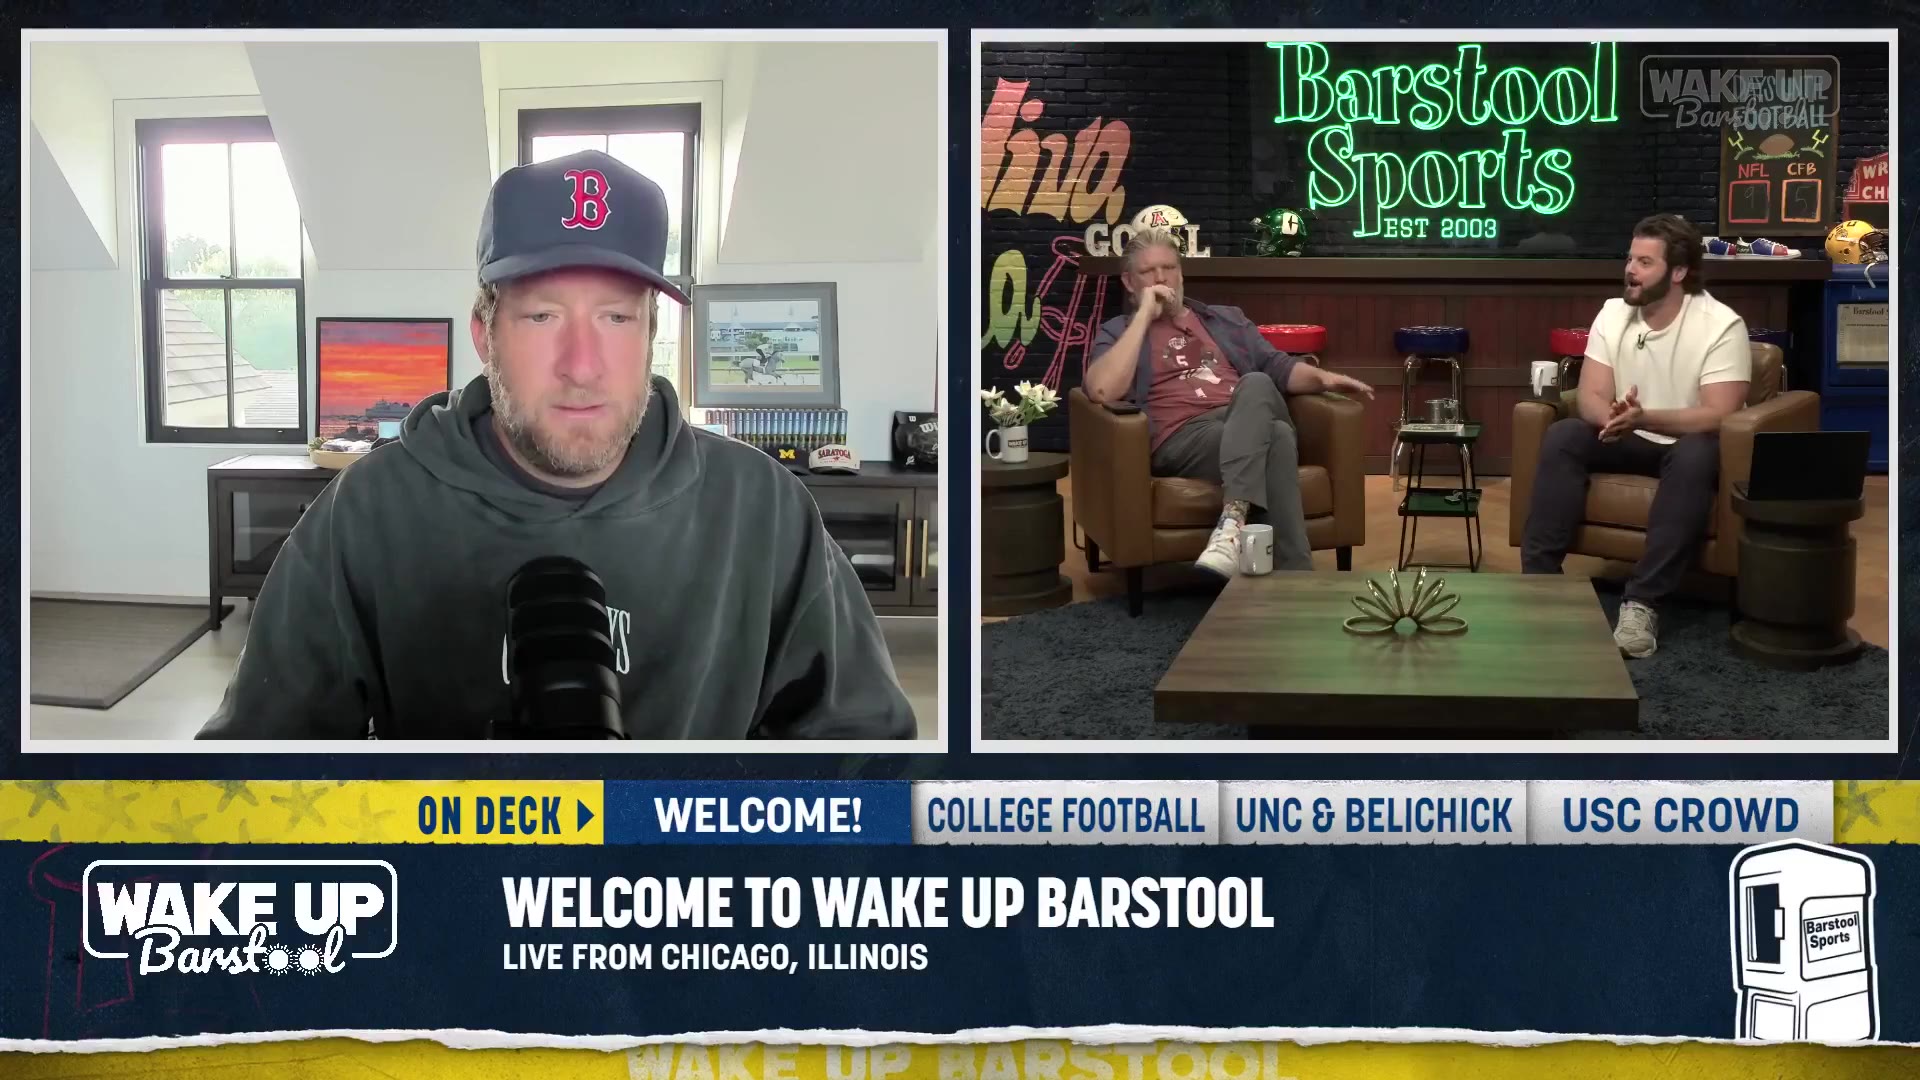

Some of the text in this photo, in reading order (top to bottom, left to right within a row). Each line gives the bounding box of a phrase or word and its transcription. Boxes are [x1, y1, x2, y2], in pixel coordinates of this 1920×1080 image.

[1266, 41, 1618, 130] Barstool
[1738, 163, 1770, 179] NFL
[1787, 162, 1817, 176] CFB
[1307, 123, 1576, 239] Sports
[561, 168, 612, 231] B
[1383, 217, 1498, 239] EST 2003
[1084, 223, 1211, 258] GOL
[779, 449, 796, 459] M
[818, 448, 851, 460] SARATOGA
